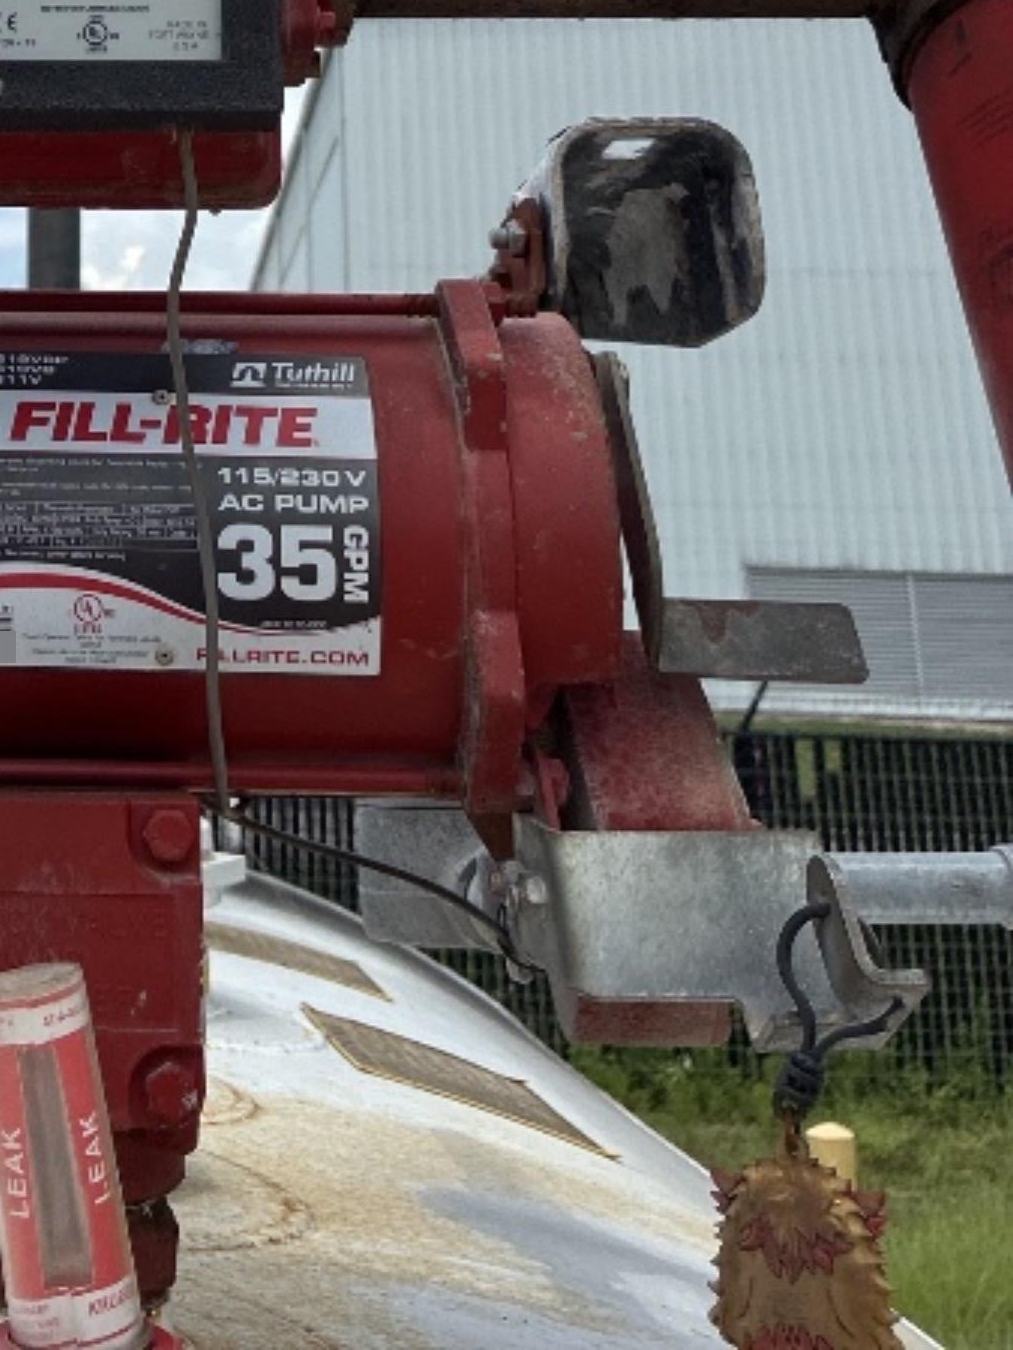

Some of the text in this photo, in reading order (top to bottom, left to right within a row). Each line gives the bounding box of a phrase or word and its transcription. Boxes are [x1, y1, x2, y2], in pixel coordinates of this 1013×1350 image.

[271, 361, 355, 382] Tuthill
[9, 402, 319, 448] FILL-RITE
[217, 467, 367, 487] 115/230 V
[218, 494, 370, 515] AC PUMP
[217, 523, 338, 601] 35
[343, 524, 369, 604] GPM
[196, 647, 369, 667] FLLRITE.COM
[1, 1127, 31, 1219] LEAK
[78, 1110, 112, 1205] LEAK
